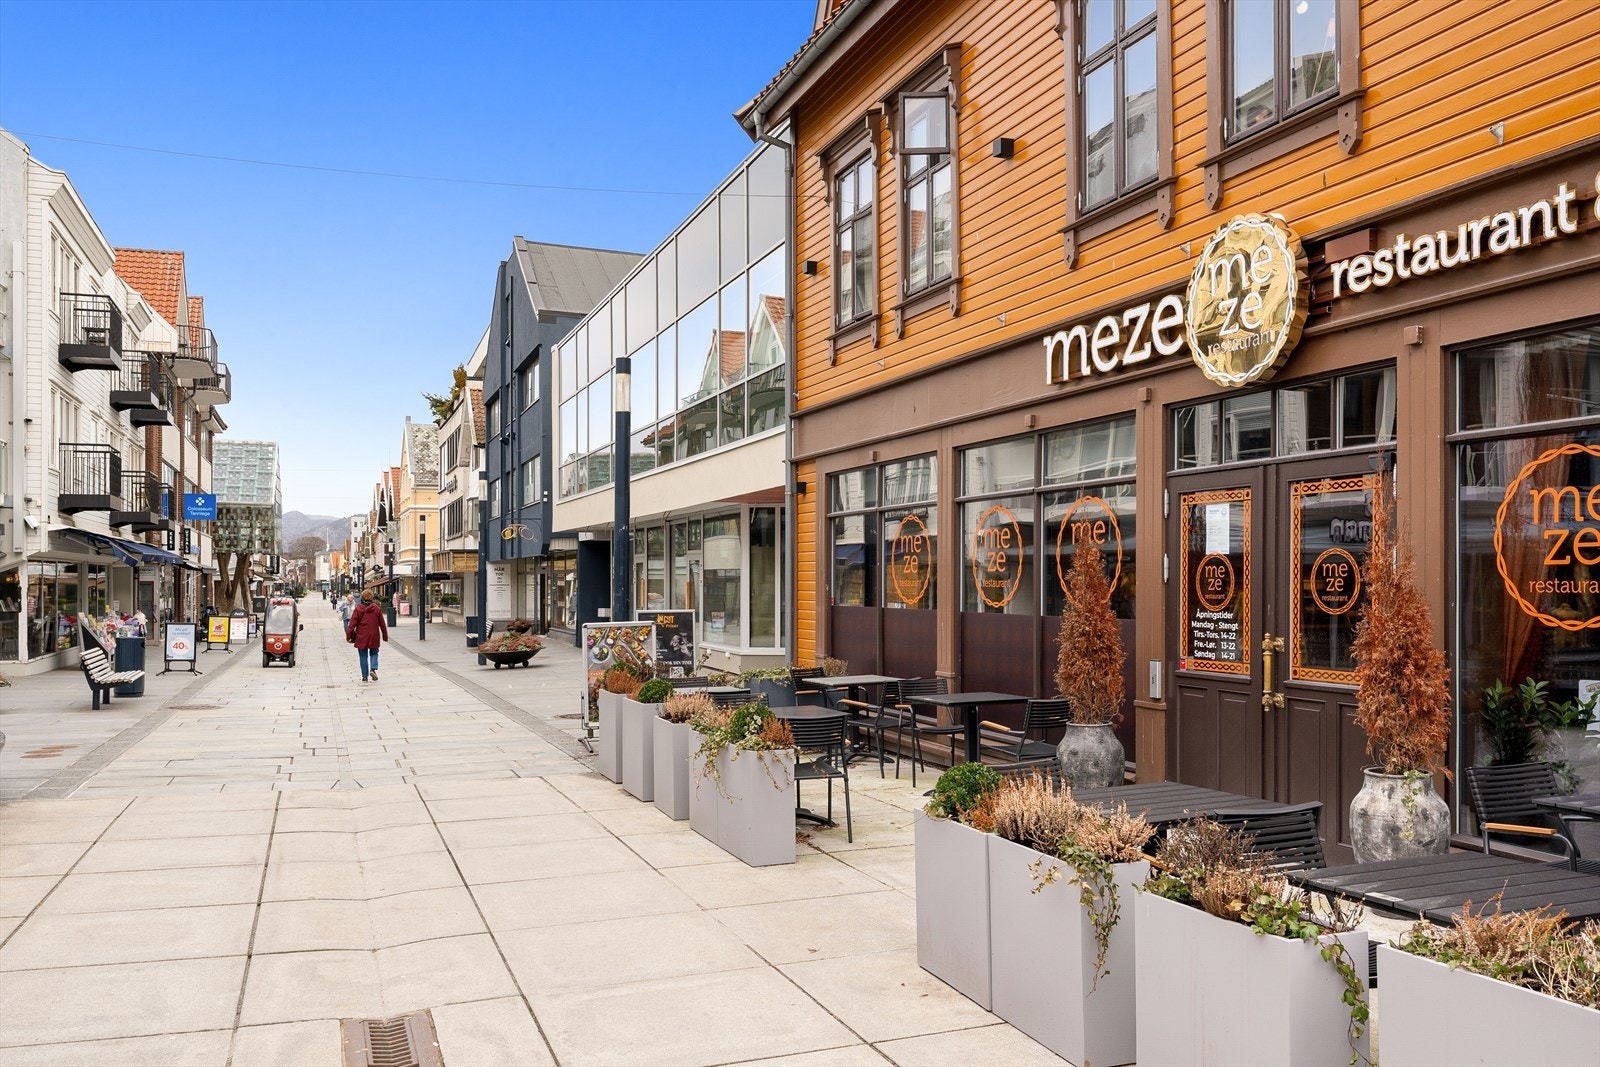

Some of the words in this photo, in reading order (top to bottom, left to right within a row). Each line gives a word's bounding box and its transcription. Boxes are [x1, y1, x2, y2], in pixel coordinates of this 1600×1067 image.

[1208, 245, 1273, 297] me
[1043, 294, 1184, 385] meze
[1330, 181, 1578, 298] restaurant
[1218, 291, 1263, 337] ze
[1207, 329, 1274, 356] restaurant
[983, 527, 1011, 550] me
[1071, 520, 1106, 545] me
[901, 533, 922, 553] me
[903, 555, 919, 573] ze
[987, 551, 1006, 573] ze
[1205, 565, 1225, 578] me
[1322, 563, 1348, 577] me
[899, 578, 922, 587] restaurant
[981, 578, 1011, 588] restaurant
[1208, 578, 1222, 591] ze
[1326, 577, 1344, 592] ze
[1321, 594, 1348, 602] restaurant
[1196, 608, 1234, 620] Åpningstider
[1191, 620, 1215, 631] Mandag
[1218, 621, 1239, 631] Stengt
[1220, 631, 1236, 640] 14-22
[1221, 642, 1236, 650] 13-22
[1194, 650, 1216, 660] Søndag
[1221, 651, 1236, 660] 14-21
